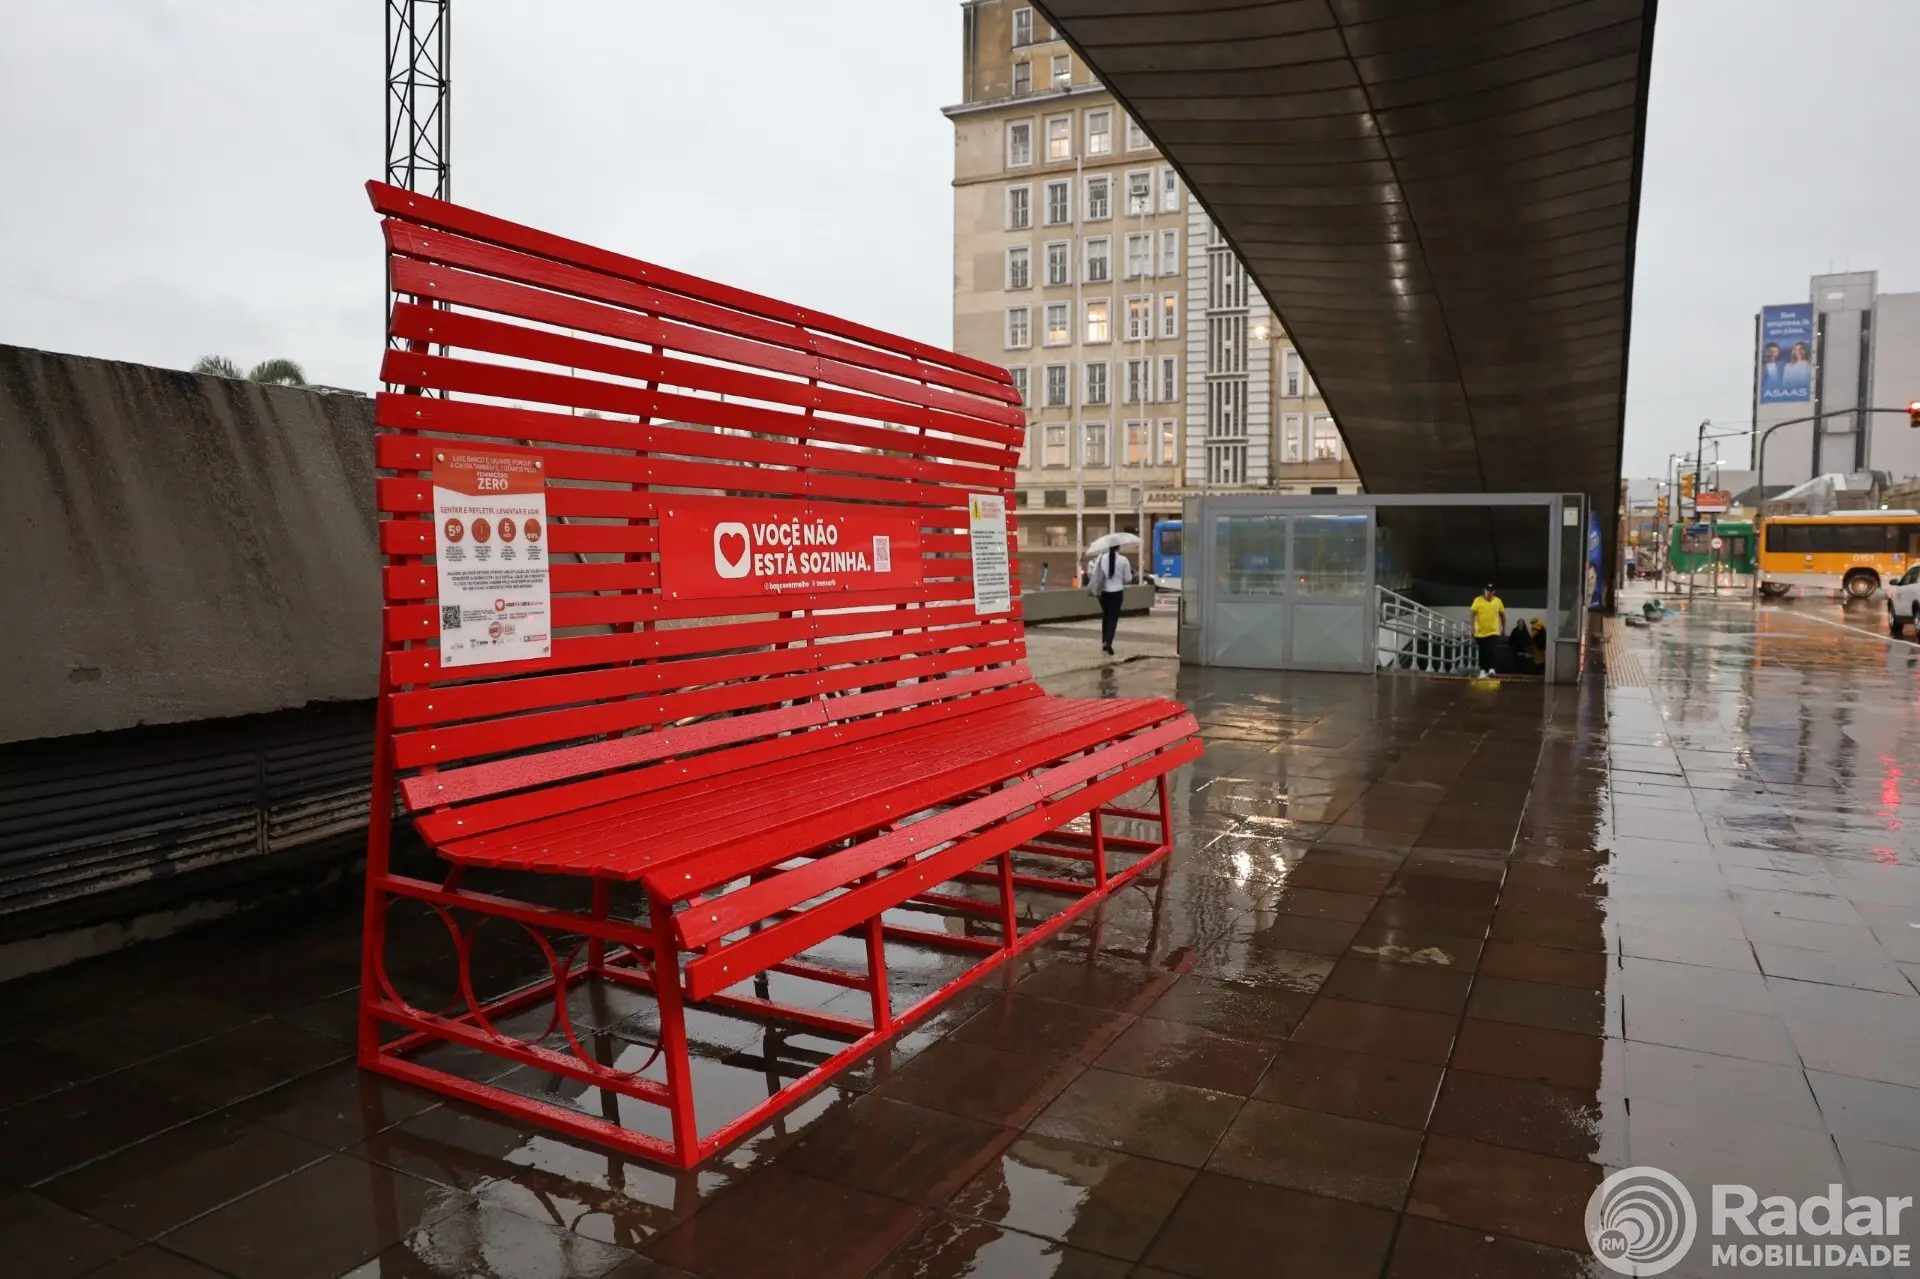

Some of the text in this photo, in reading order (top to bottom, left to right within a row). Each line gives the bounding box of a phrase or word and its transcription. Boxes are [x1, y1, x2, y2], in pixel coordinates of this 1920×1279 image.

[1764, 388, 1808, 398] ASAAS
[477, 478, 509, 490] ZERO
[440, 506, 462, 514] SENTAR
[504, 522, 510, 532] 6
[752, 517, 838, 546] VOCÊ NÃO
[754, 545, 871, 576] ESTÁ SOZINHA.
